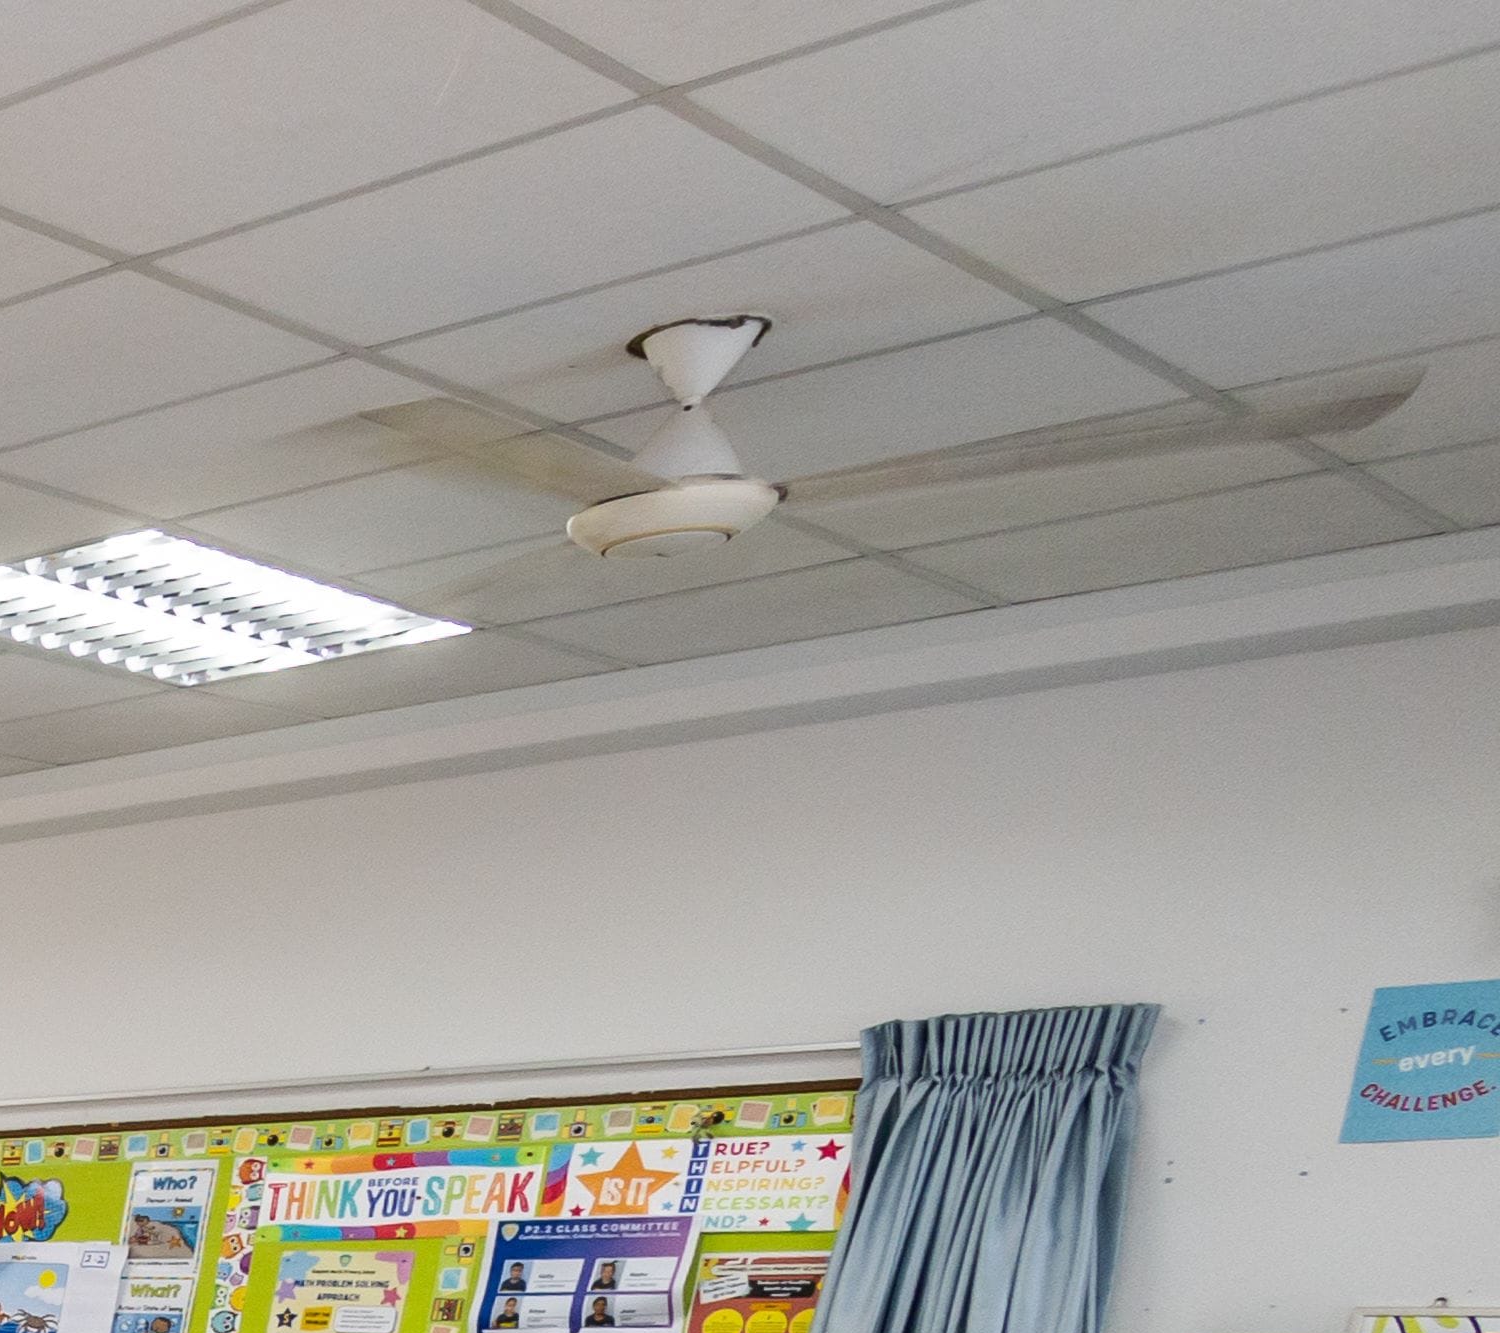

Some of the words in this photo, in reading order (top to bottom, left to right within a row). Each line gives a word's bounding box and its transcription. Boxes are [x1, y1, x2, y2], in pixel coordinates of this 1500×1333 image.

[1380, 1009, 1500, 1041] EMBRACE
[1399, 1046, 1476, 1071] every
[1360, 1080, 1496, 1112] CHALLENGE.
[153, 1176, 197, 1191] Who?
[368, 1177, 419, 1187] BEFORE
[269, 1178, 362, 1221] THINK
[422, 1171, 535, 1215] SPEAK
[599, 1177, 622, 1206] IS
[625, 1177, 655, 1207] IT
[556, 1223, 597, 1234] CLASS
[601, 1221, 680, 1233] COMMITTEE
[704, 1215, 748, 1229] ND?
[131, 1284, 181, 1298] What?
[316, 1279, 352, 1289] PROBLEM
[317, 1293, 361, 1301] APPROACH
